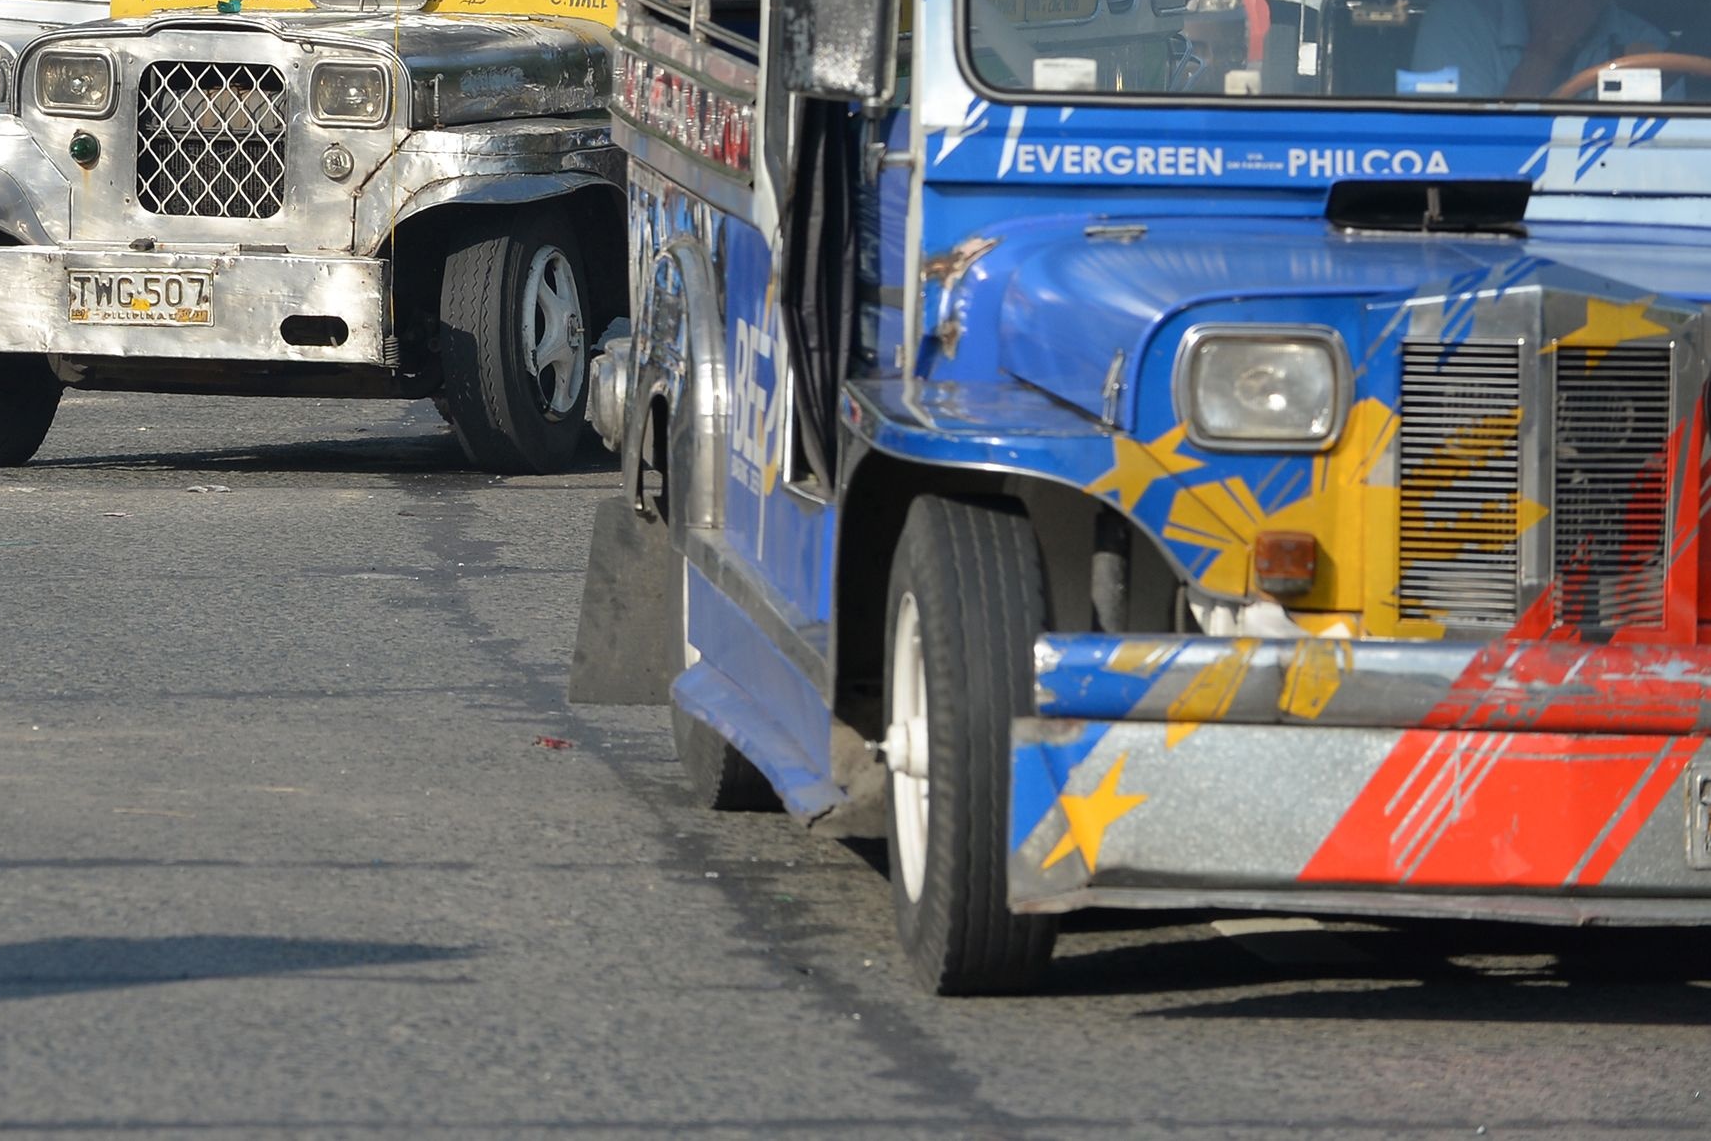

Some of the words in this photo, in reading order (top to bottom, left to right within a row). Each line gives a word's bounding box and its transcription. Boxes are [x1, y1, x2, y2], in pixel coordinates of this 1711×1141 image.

[1017, 145, 1223, 177] EVERGREEN
[1288, 148, 1450, 177] PHILCOA
[73, 276, 133, 307] TWG
[144, 277, 205, 307] 507
